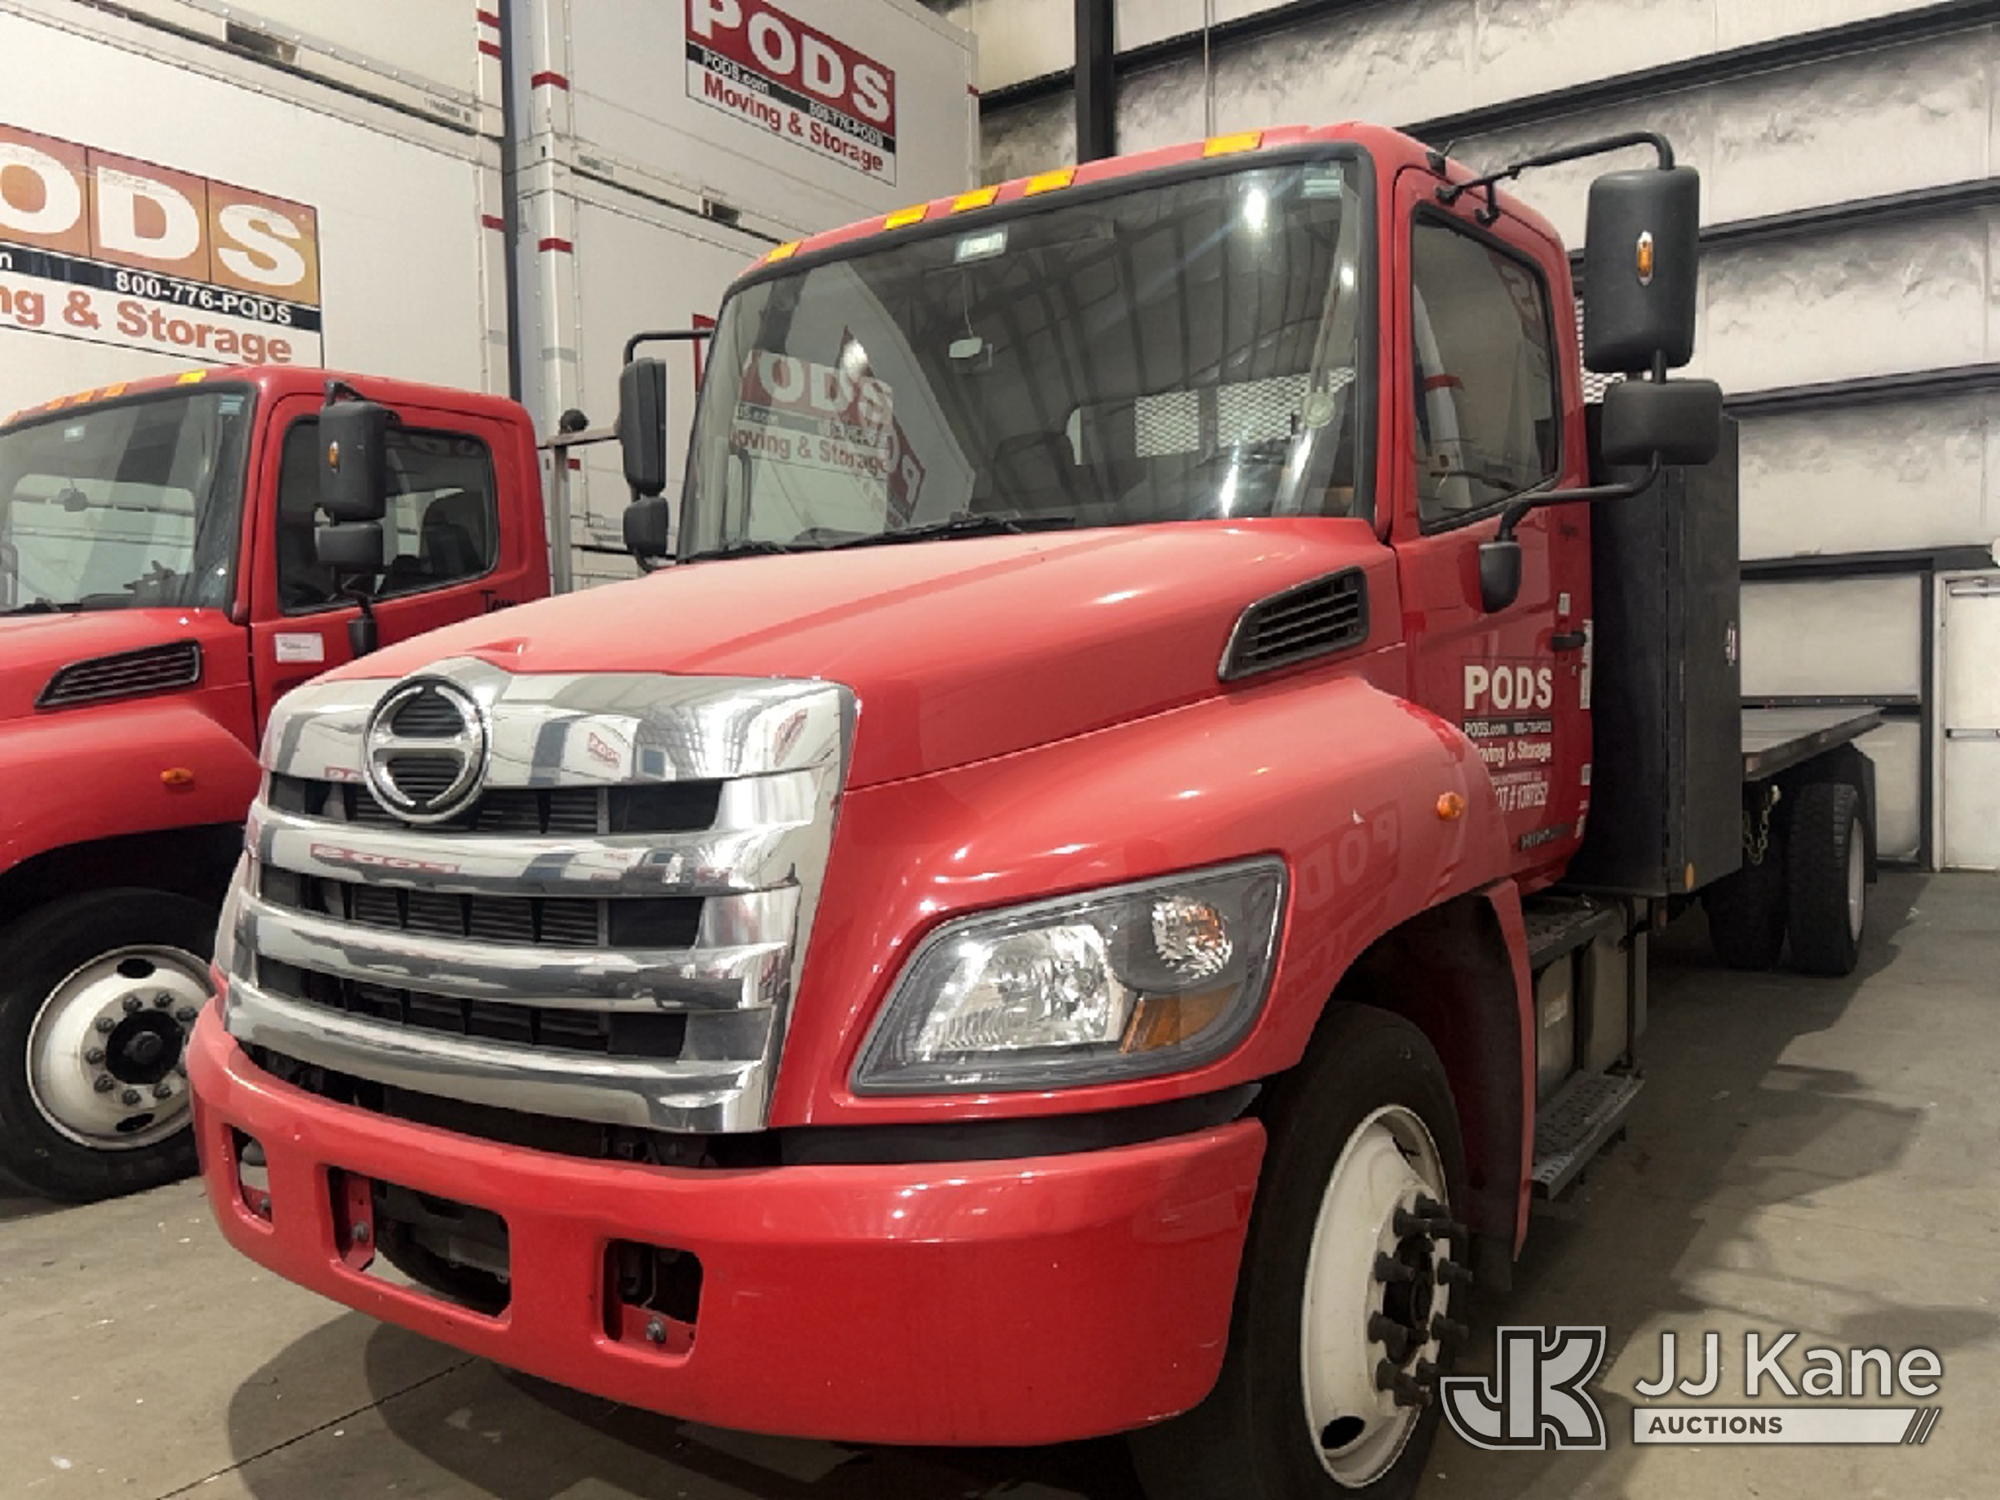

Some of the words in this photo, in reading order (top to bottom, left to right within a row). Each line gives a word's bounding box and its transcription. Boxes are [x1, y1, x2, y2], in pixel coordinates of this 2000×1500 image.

[691, 0, 891, 123] PODS
[703, 51, 769, 95] PODS.com
[704, 72, 782, 132] Moving
[788, 111, 804, 137] &
[810, 119, 884, 171] Storage
[115, 271, 292, 325] 800-776-PODS
[63, 289, 101, 330] &
[117, 300, 292, 364] Storage
[1464, 665, 1553, 710] PODS
[1517, 740, 1552, 762] Storage
